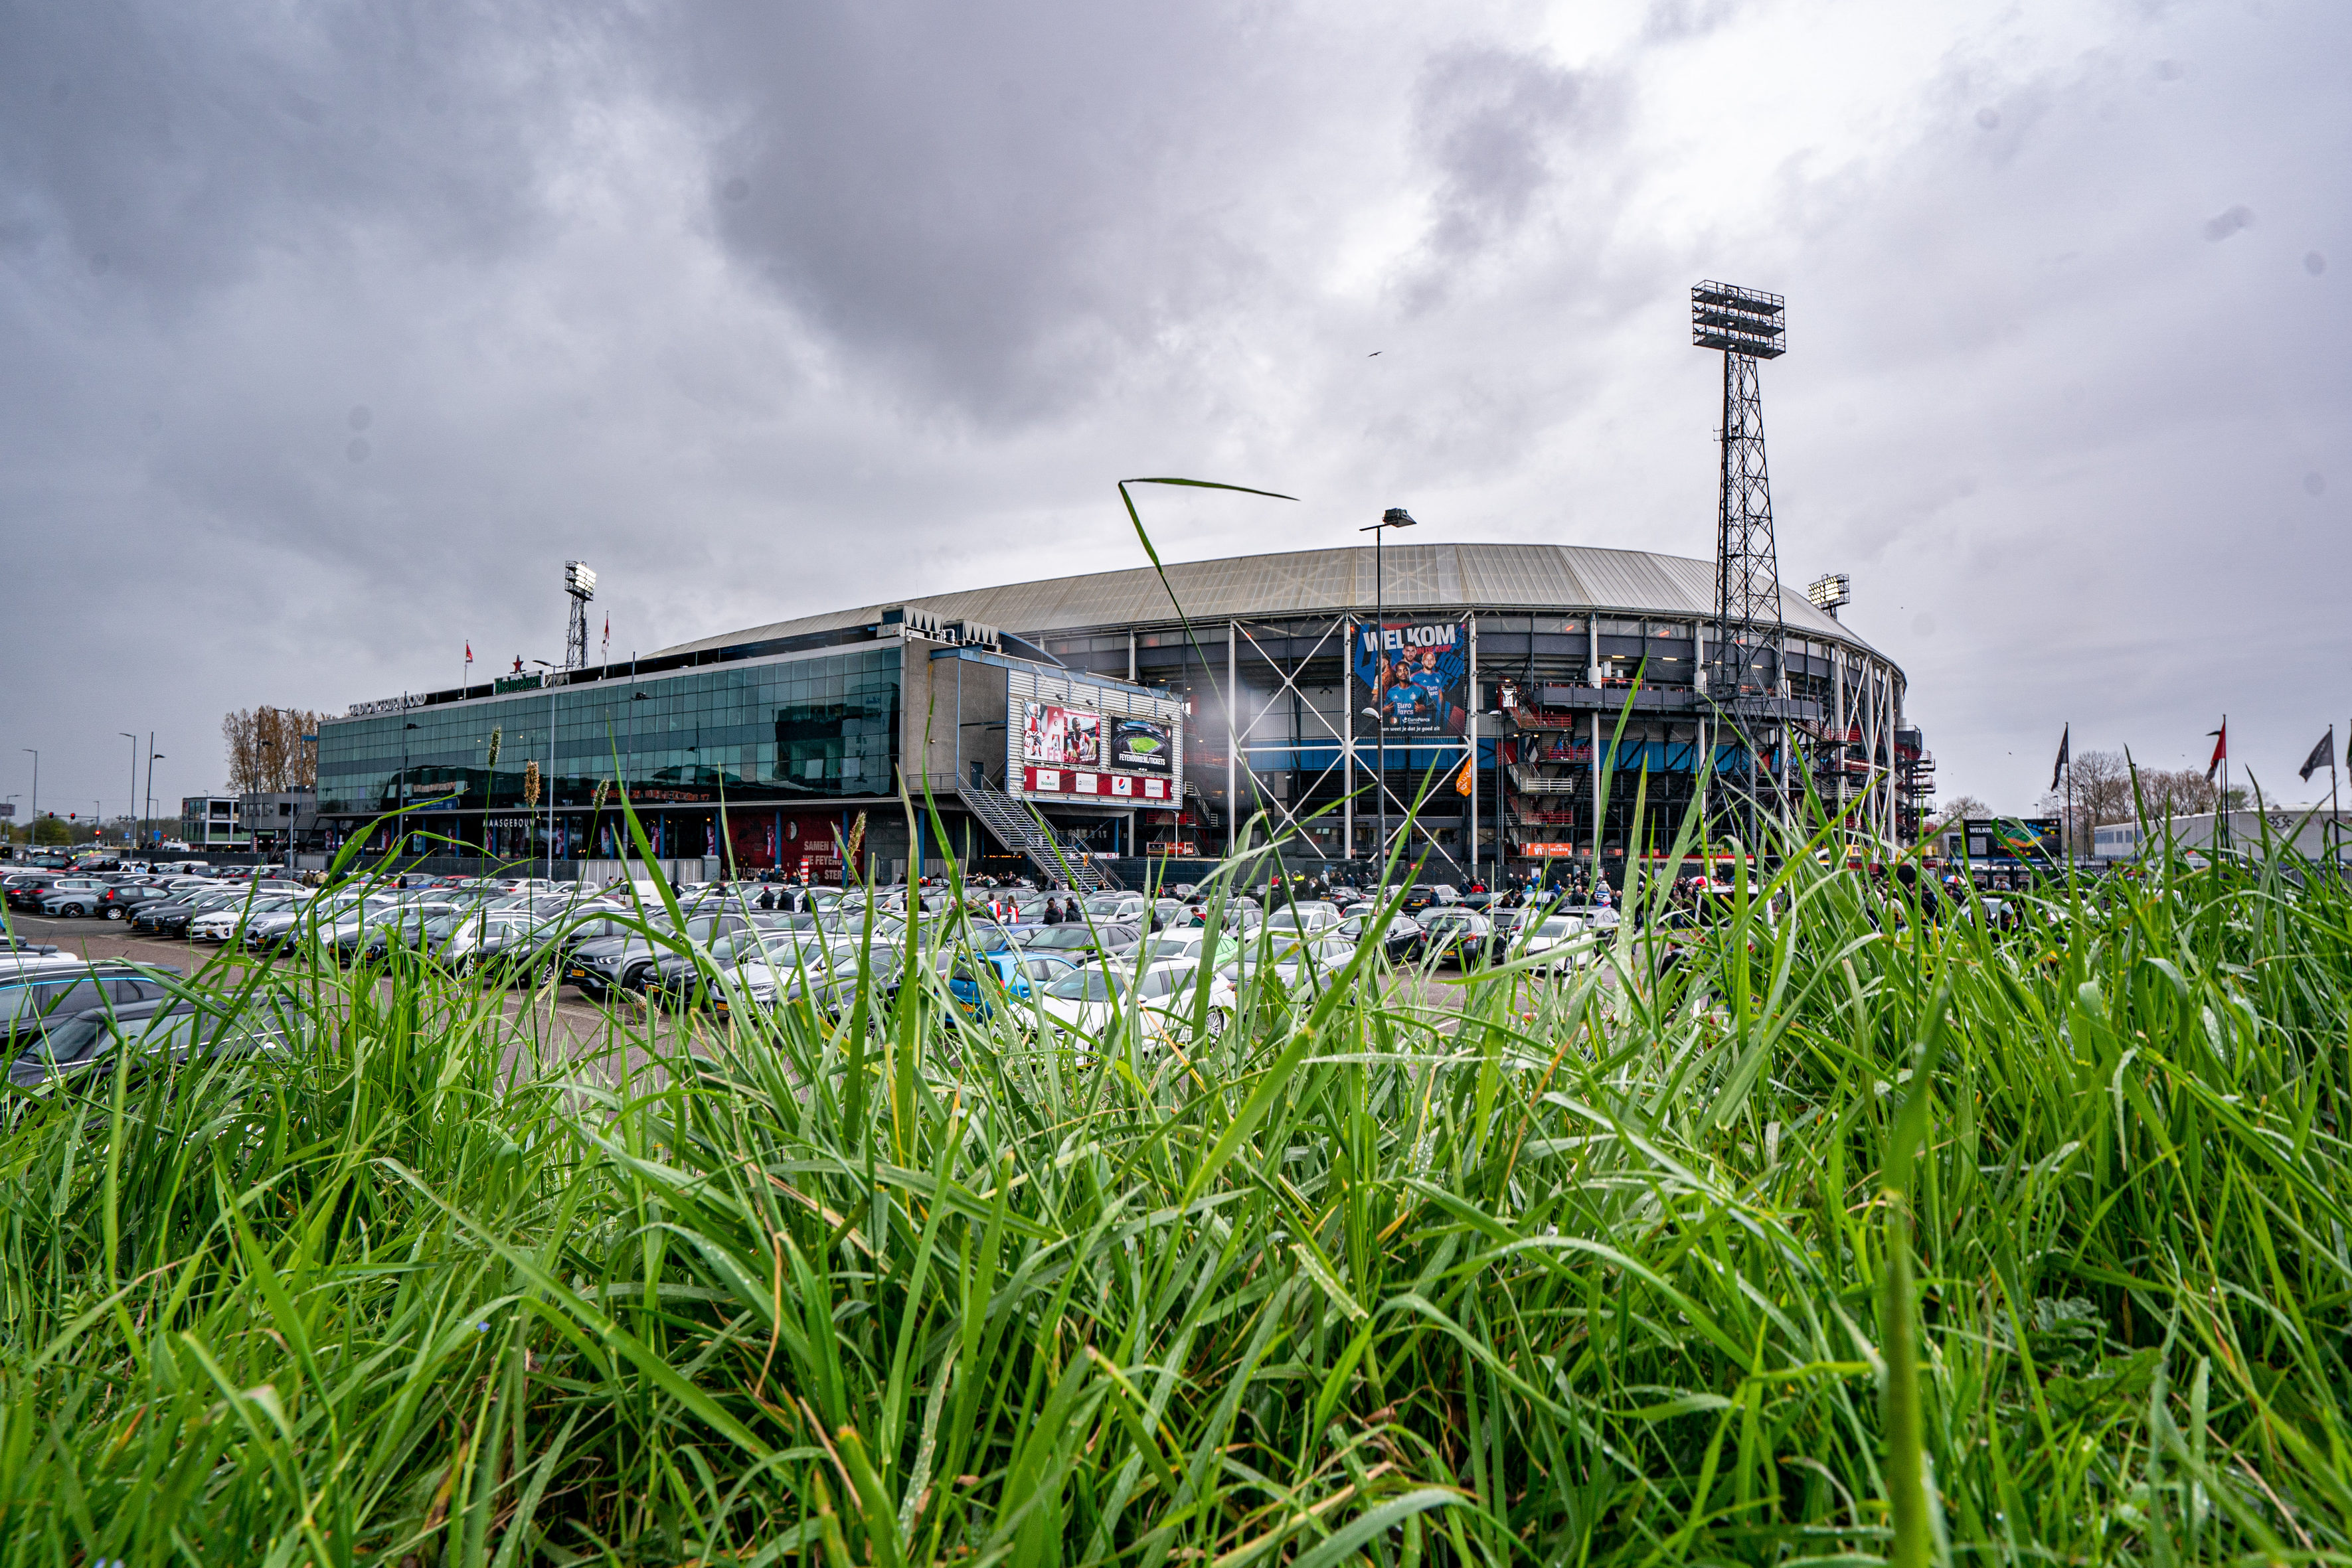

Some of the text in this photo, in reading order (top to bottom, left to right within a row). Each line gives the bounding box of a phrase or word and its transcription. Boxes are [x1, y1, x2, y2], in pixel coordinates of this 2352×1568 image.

[1363, 624, 1456, 652] WELKOM
[495, 674, 542, 694] Heineken
[483, 819, 536, 828] MAASGEBOUW
[804, 840, 829, 851] SAMEN
